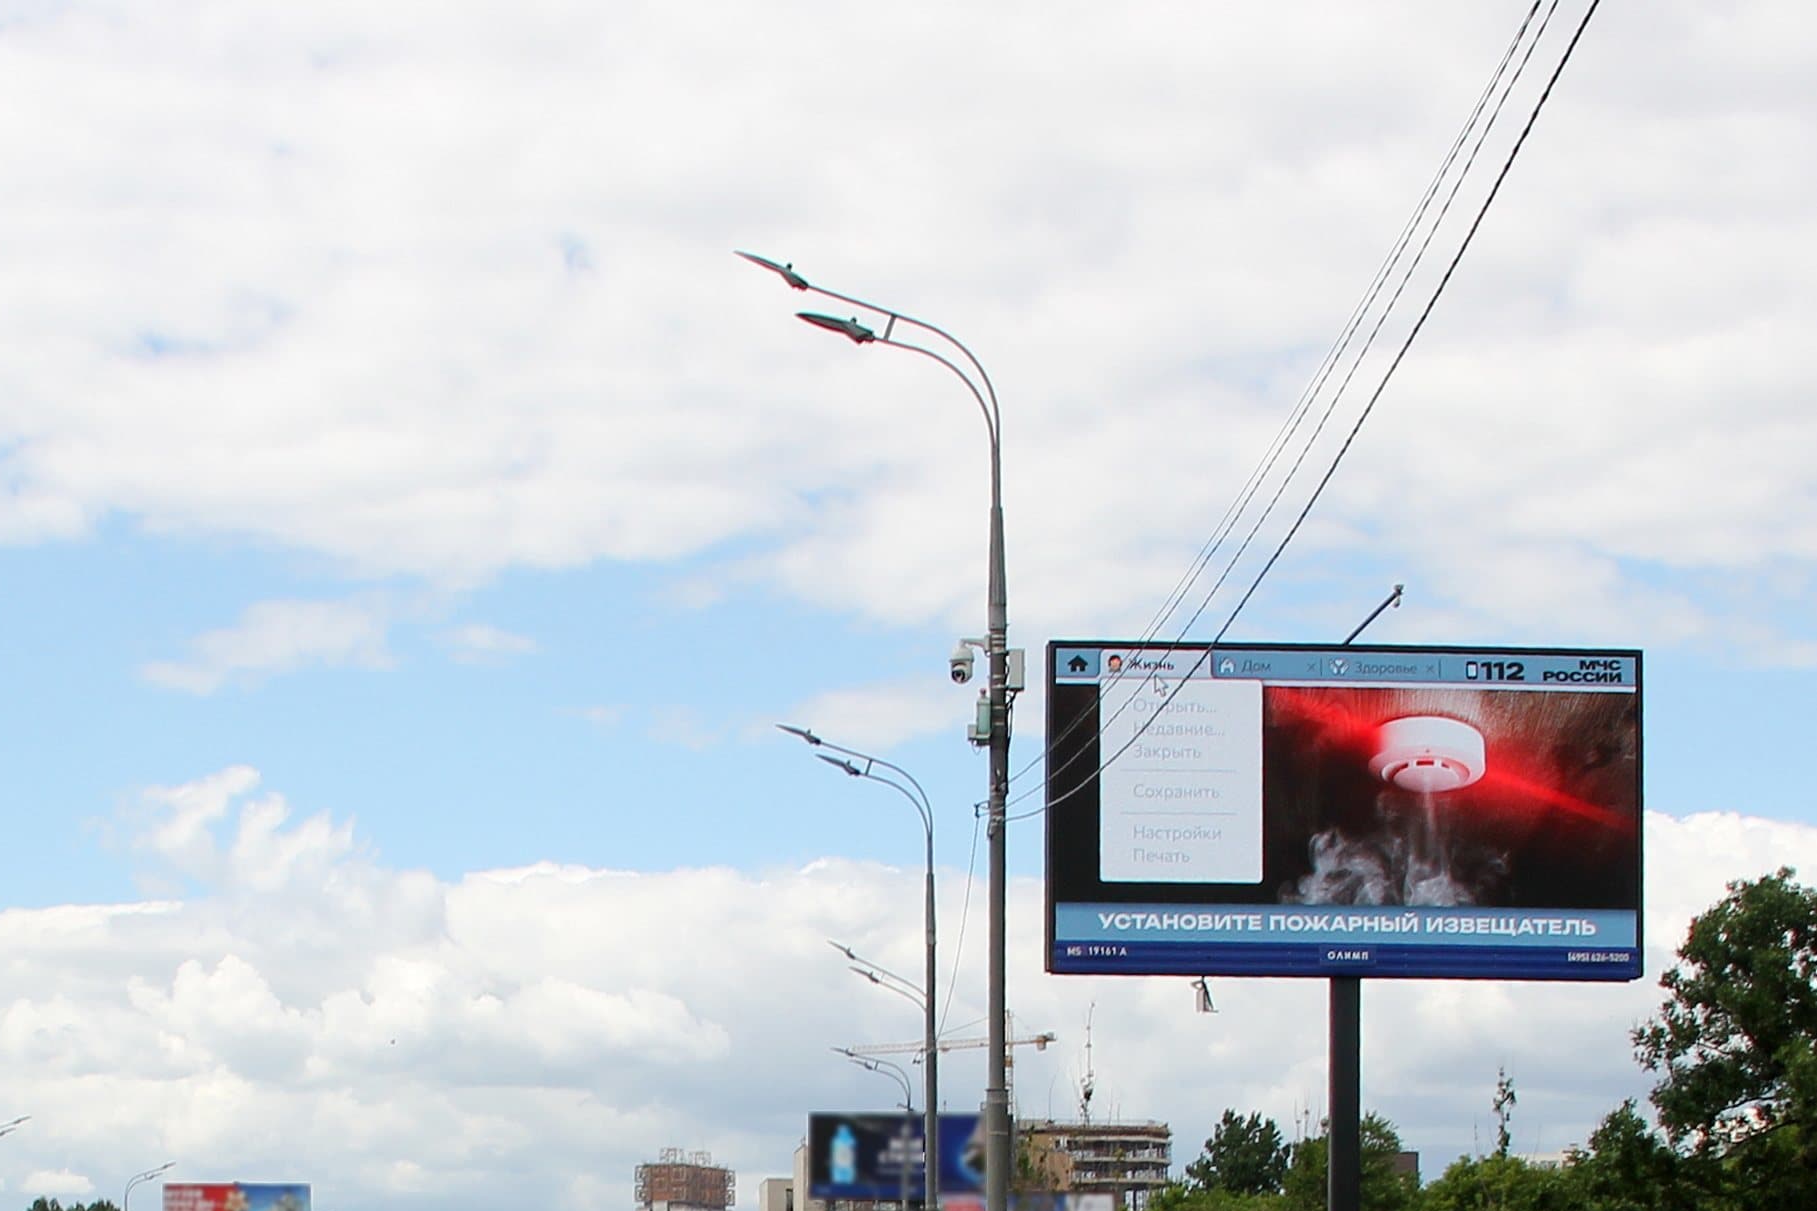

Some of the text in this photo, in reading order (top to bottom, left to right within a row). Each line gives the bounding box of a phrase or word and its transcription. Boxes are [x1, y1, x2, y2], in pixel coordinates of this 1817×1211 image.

[1129, 658, 1175, 672] Жизнь
[1241, 662, 1272, 674] Дом
[1355, 661, 1418, 677] Здоровье
[1481, 661, 1525, 681] 112
[1579, 659, 1623, 671] МЧС
[1542, 671, 1623, 683] РОССИИ
[1133, 746, 1202, 762] Закрыть
[1133, 784, 1220, 801] Сохранить
[1133, 825, 1223, 843] Настройки
[1133, 848, 1191, 863] Печать
[1098, 912, 1597, 936] УСТАНОВИТЕ ПОЖАРНЫЙ ИЗВЕЩАТЕЛЬ
[1327, 949, 1369, 961] ОЛИМП
